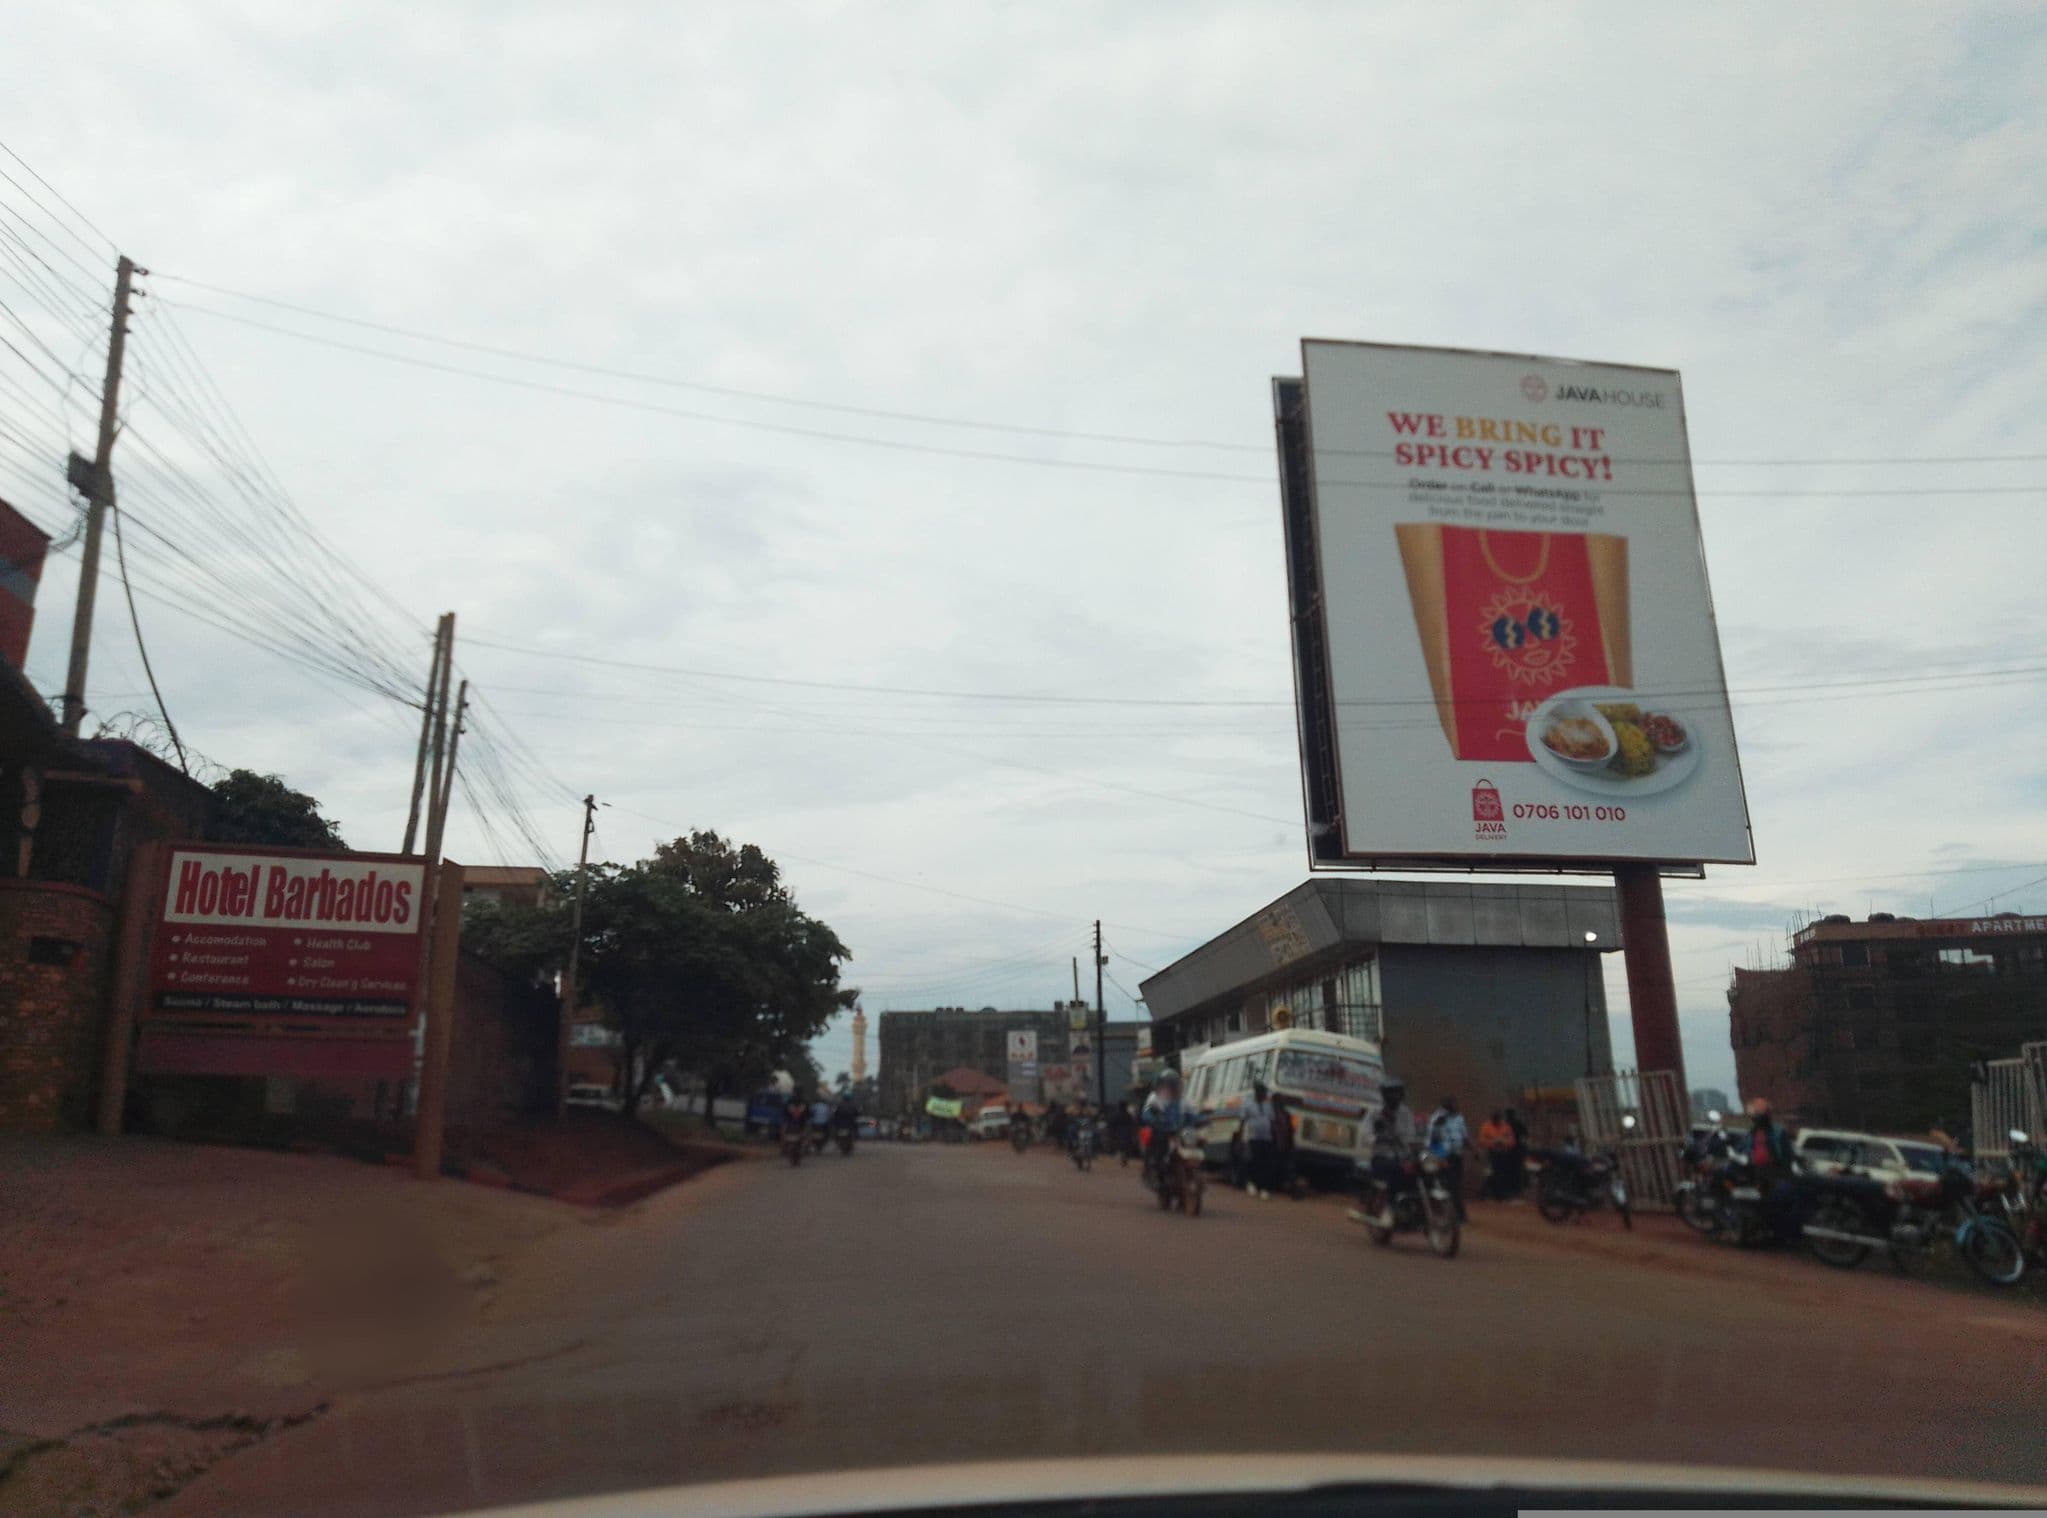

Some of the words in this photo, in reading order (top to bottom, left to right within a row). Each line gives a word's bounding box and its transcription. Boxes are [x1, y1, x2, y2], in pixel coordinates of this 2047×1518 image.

[1386, 411, 1447, 437] WE
[1454, 415, 1563, 448] BRING
[1571, 425, 1606, 450] IT
[1395, 442, 1495, 470] SPICY
[1504, 449, 1613, 481] SPICY!
[1408, 478, 1448, 491] Order
[1516, 484, 1581, 501] WhatsApp
[1512, 803, 1560, 820] 0706
[1564, 805, 1591, 821] 101
[1595, 806, 1627, 822] 010
[1474, 822, 1507, 833] JAVA
[174, 860, 261, 918] Hotel
[263, 865, 412, 924] Barbados
[181, 951, 249, 965] Restaurant
